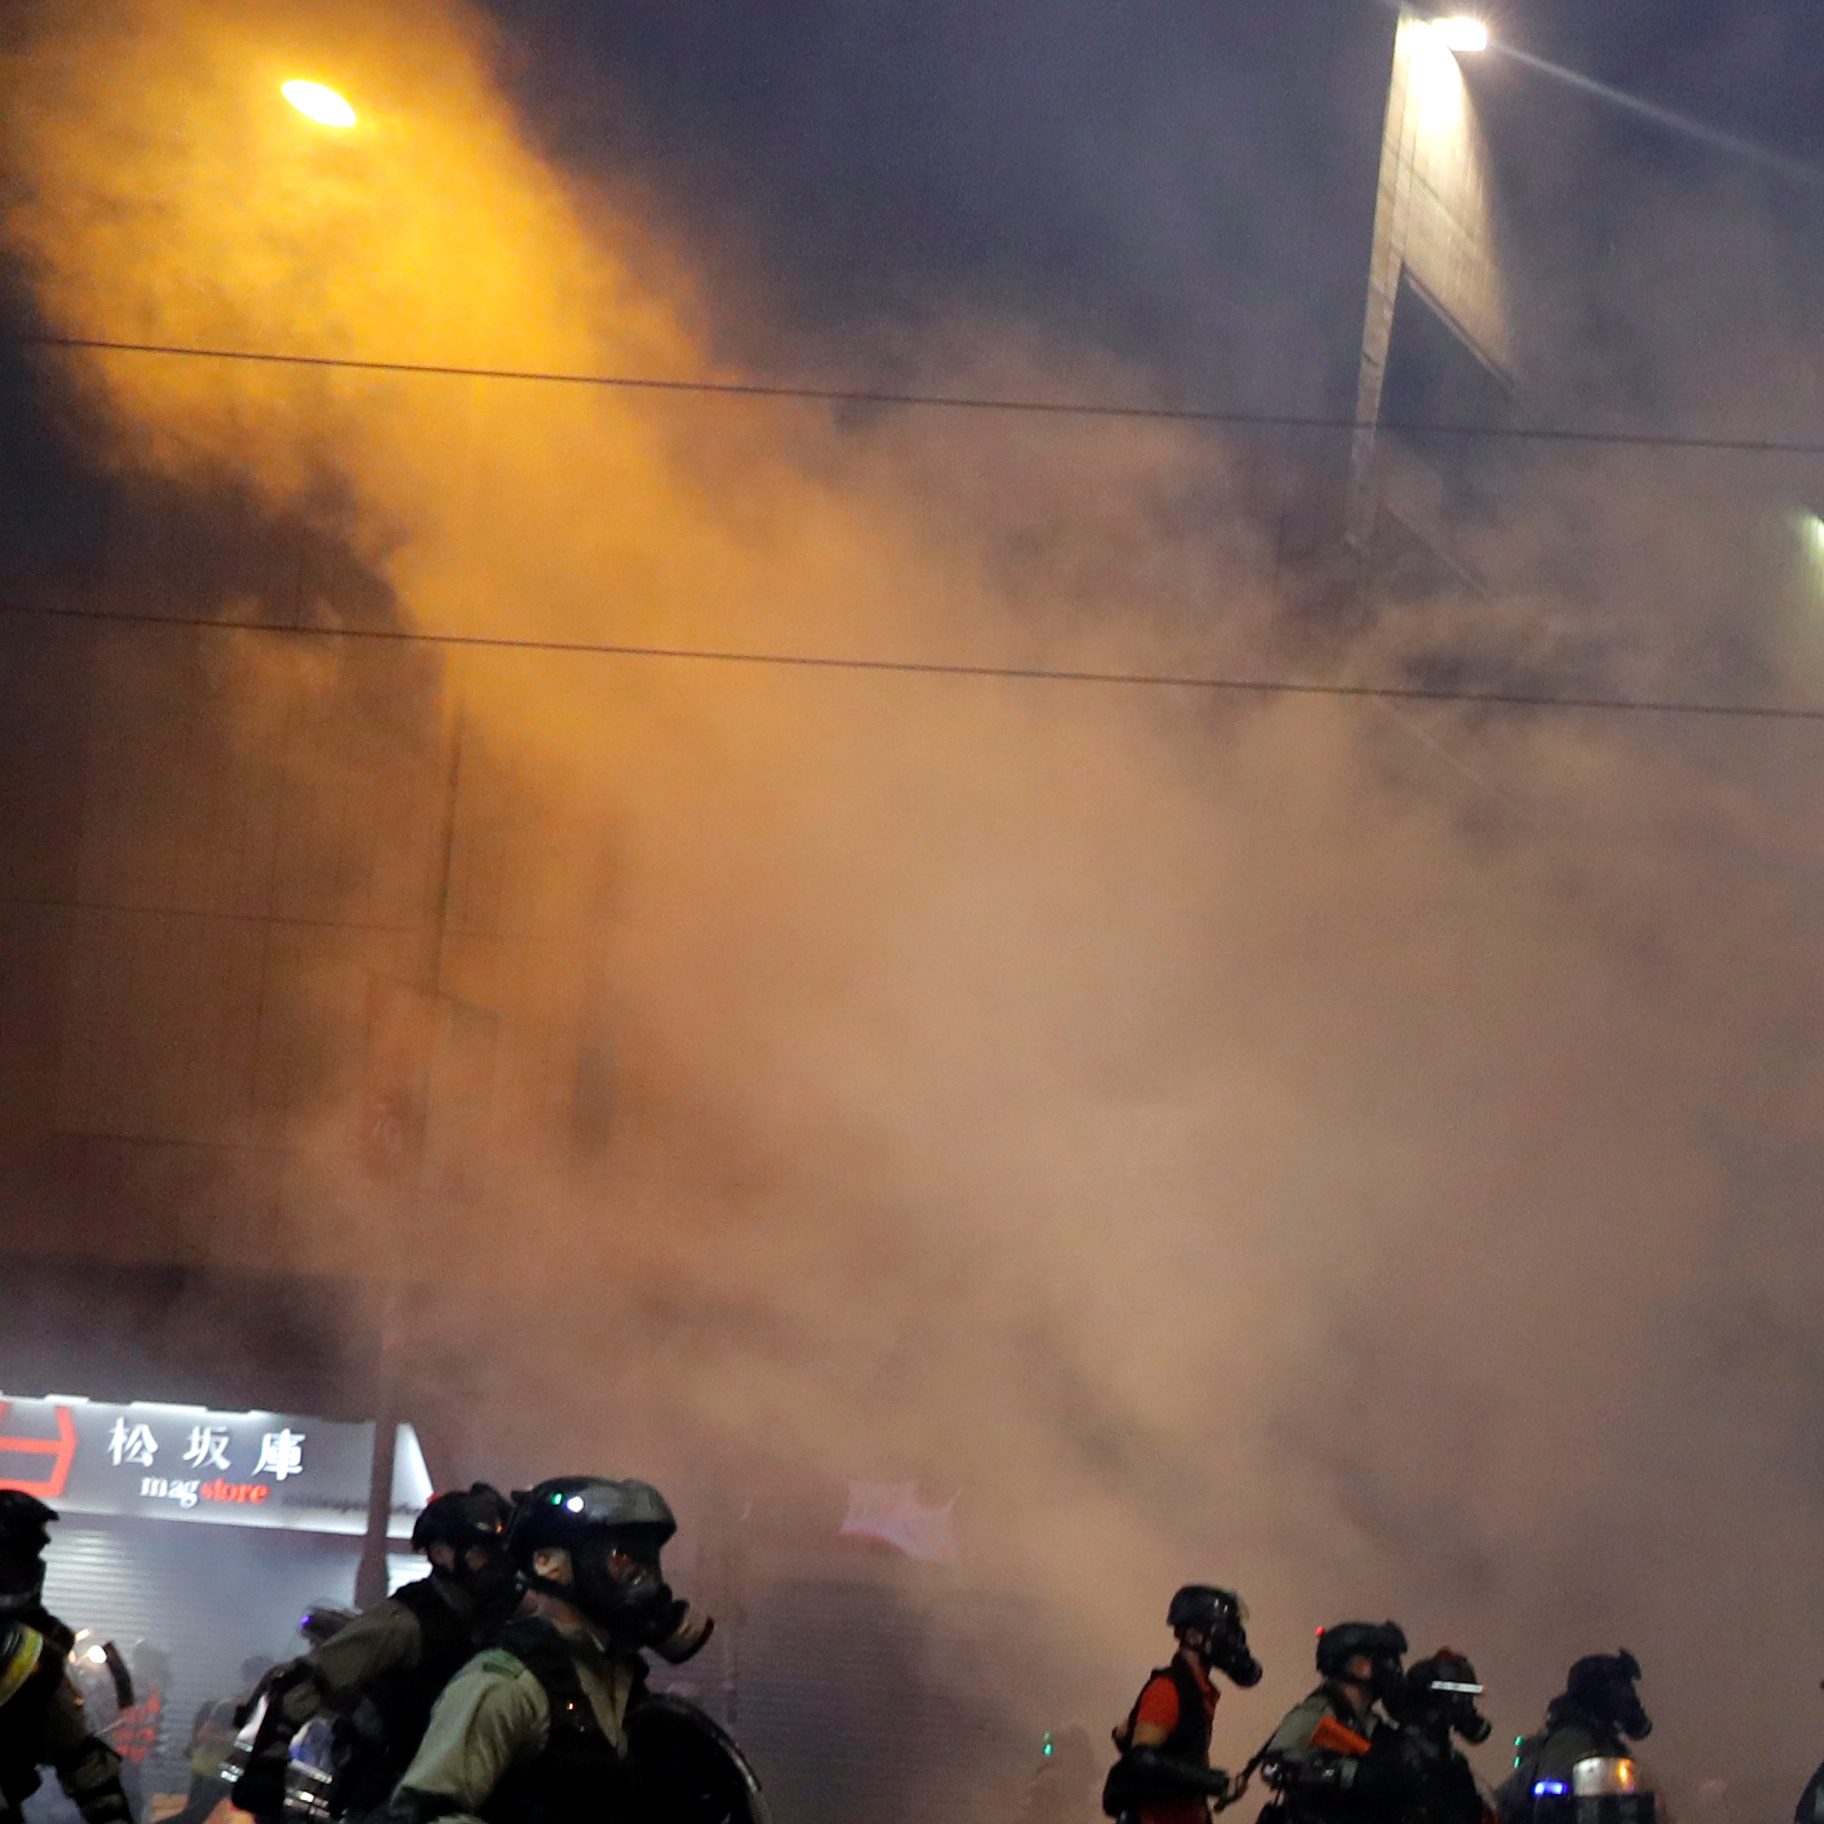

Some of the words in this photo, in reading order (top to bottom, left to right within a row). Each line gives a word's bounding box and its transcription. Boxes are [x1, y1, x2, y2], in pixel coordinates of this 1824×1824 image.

[107, 1416, 306, 1481] 松坂庫
[140, 1476, 271, 1509] magstore
